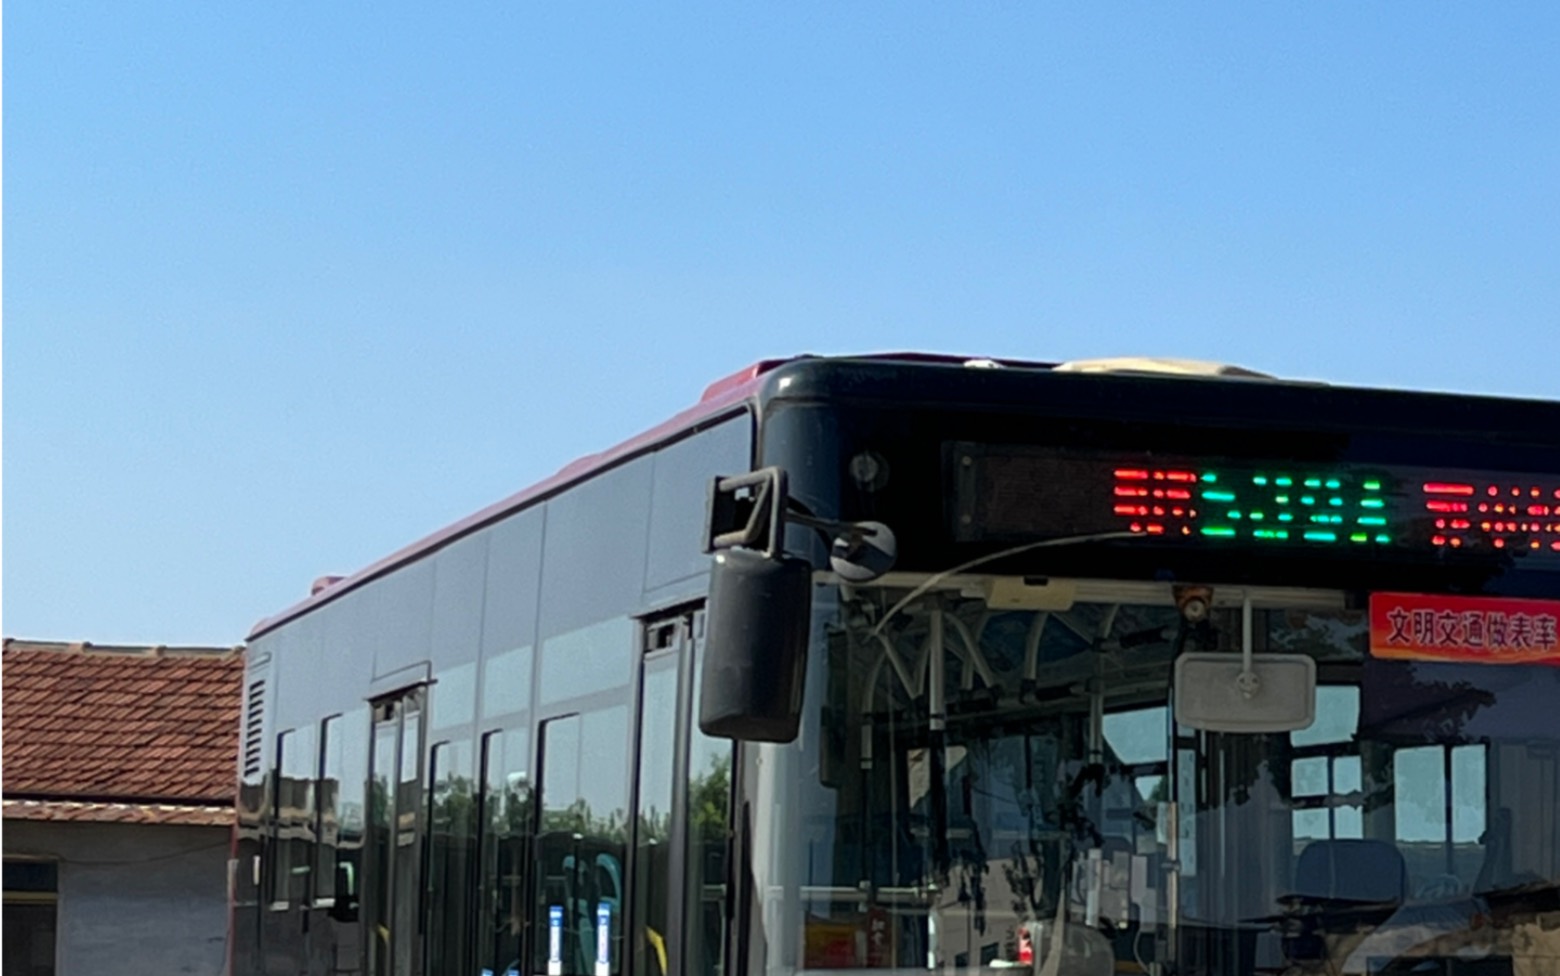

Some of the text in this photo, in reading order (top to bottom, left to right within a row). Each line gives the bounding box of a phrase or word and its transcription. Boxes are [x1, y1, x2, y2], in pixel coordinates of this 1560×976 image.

[1386, 605, 1558, 651] 文明交通做表率
